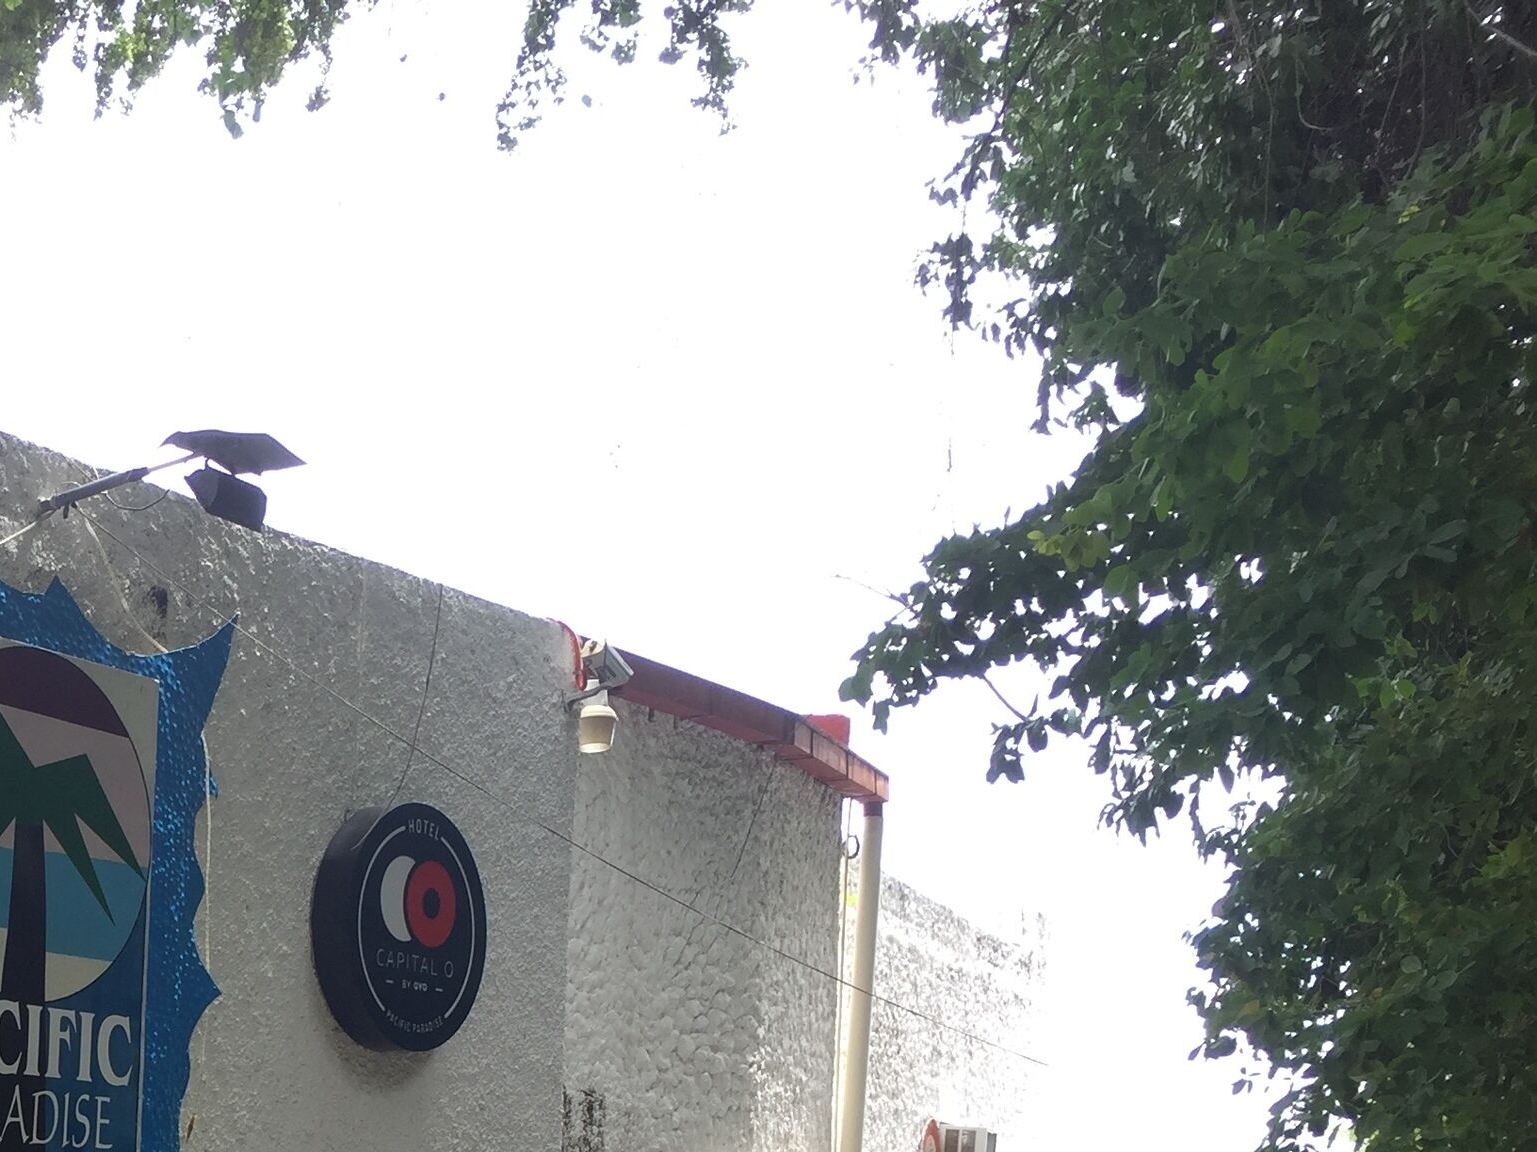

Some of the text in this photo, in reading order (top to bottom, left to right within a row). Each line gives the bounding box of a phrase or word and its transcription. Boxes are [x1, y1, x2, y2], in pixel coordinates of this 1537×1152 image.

[408, 819, 442, 841] HOTEL
[376, 948, 454, 978] CAPITAL O
